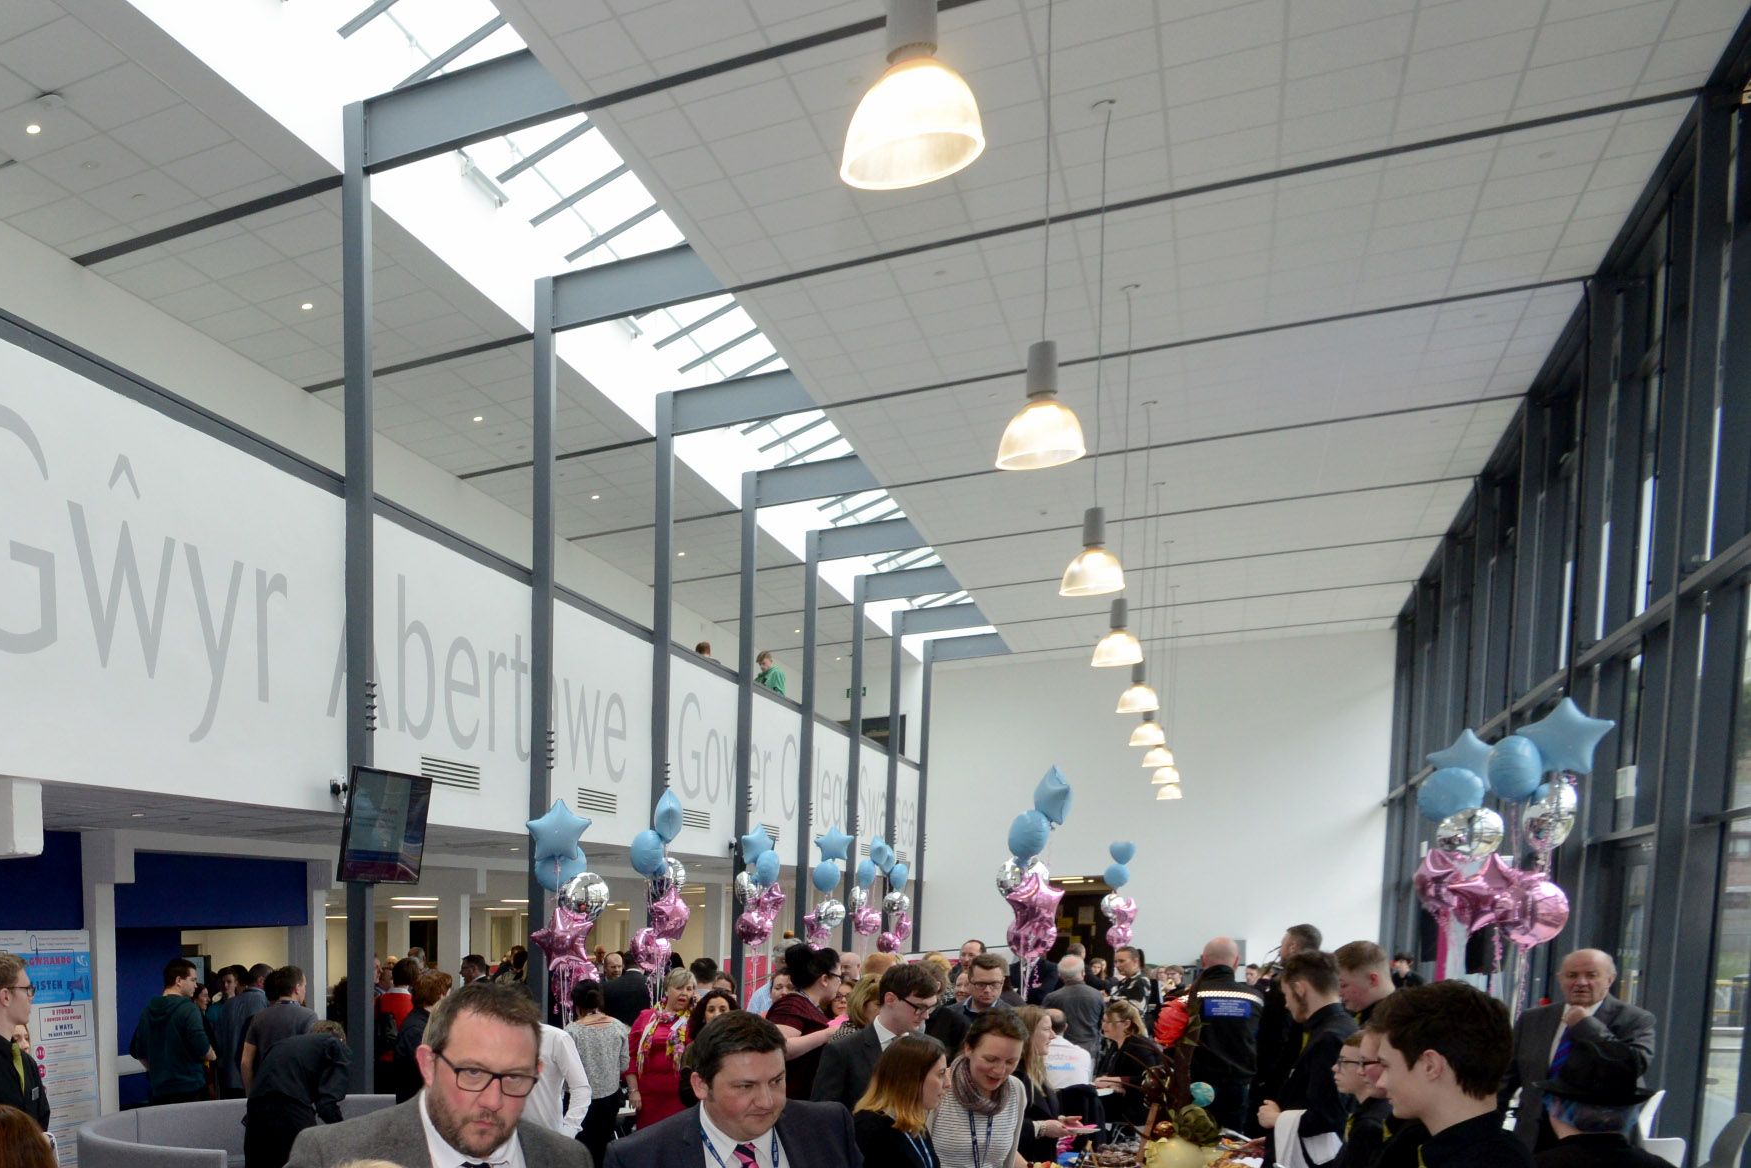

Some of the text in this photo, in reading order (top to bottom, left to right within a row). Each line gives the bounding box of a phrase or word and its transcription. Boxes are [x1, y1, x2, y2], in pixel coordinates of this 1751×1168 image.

[326, 573, 627, 783] Abertwe
[860, 766, 914, 848] Swasea
[29, 955, 72, 966] GWRANDO
